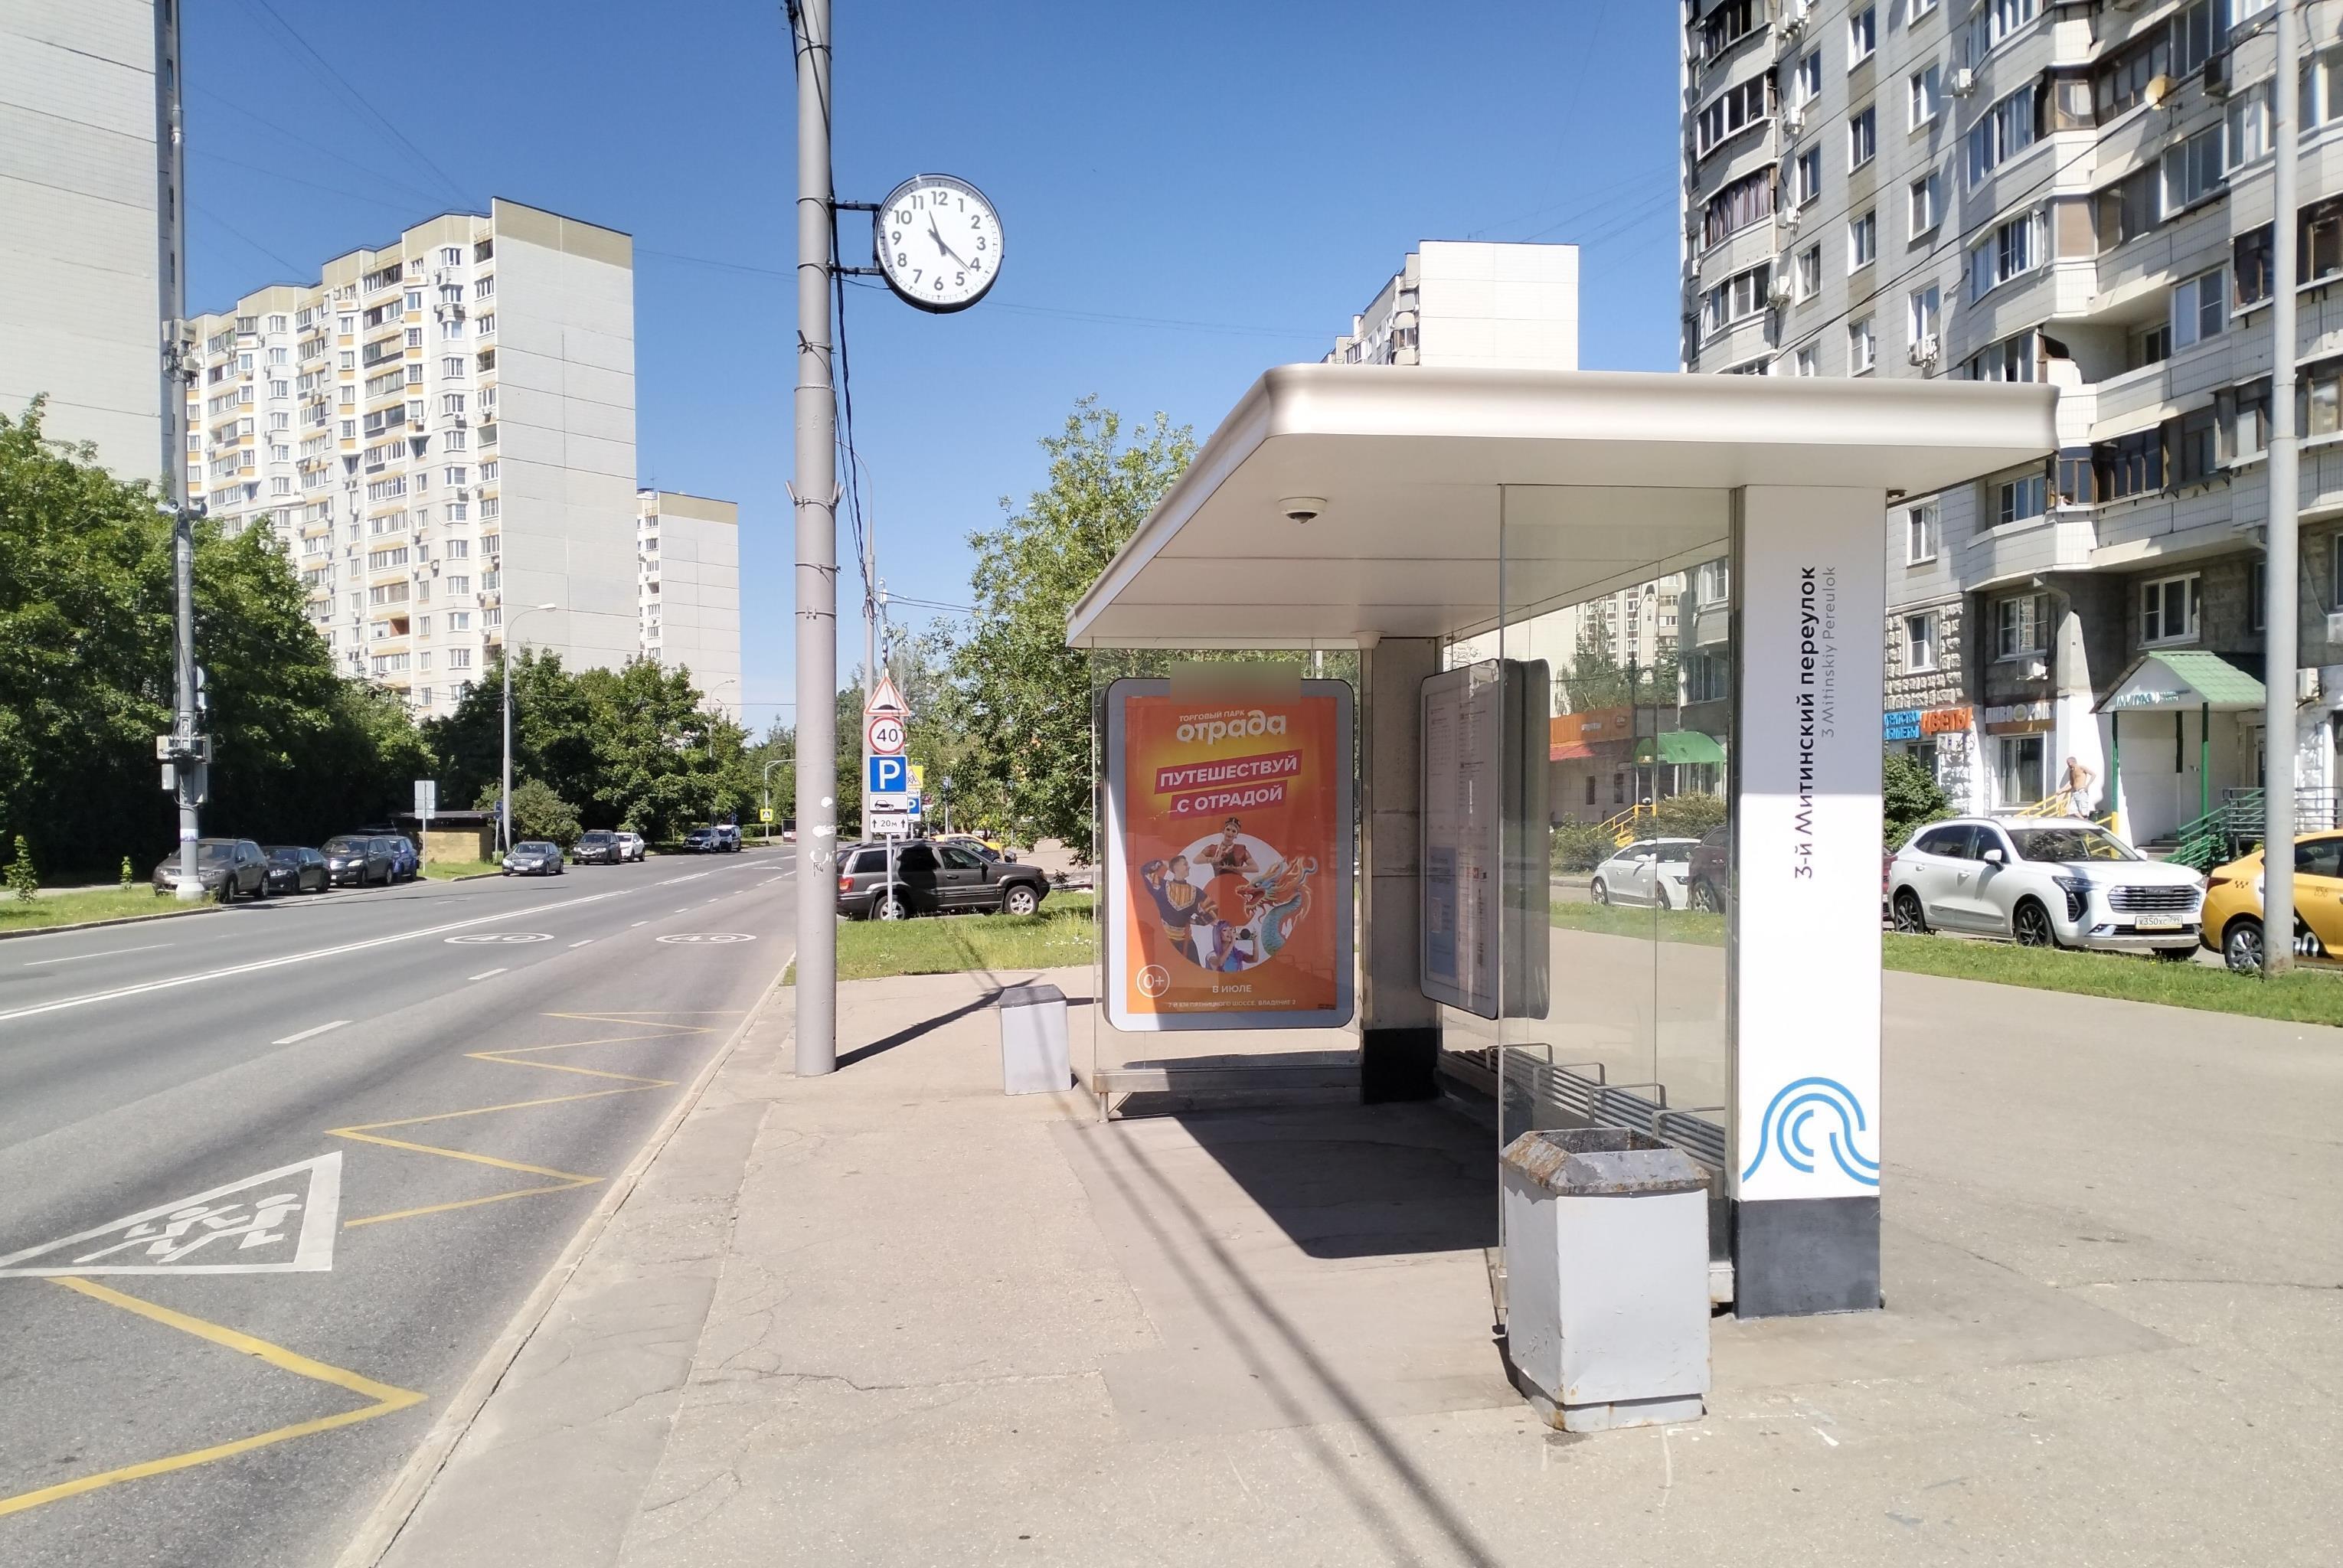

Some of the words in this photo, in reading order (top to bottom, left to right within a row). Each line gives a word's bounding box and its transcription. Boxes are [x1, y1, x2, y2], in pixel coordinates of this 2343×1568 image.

[910, 195, 923, 210] 11
[931, 191, 948, 205] 12
[958, 198, 963, 213] 1
[894, 210, 913, 224] 10
[971, 214, 981, 230] 2
[891, 231, 902, 245] 9
[976, 237, 986, 250] 3
[897, 253, 907, 267] 8
[969, 257, 982, 272] 4
[913, 270, 923, 283] 7
[934, 276, 943, 291] 6
[956, 272, 965, 286] 5
[1822, 567, 1835, 639] Pereulok
[1801, 567, 1819, 684] переулок
[1822, 645, 1838, 724] Mitinskiy
[1179, 710, 1222, 722] ТОРГОВЫЙ
[1224, 710, 1244, 718] ПАРК
[1921, 707, 1973, 737] ЦВЕТЫ
[877, 729, 898, 743] 40
[1822, 728, 1835, 738] 3
[1160, 755, 1297, 787] ПУТЕШЕСТВУЙ
[1795, 694, 1814, 835] Митинский
[880, 760, 900, 789] P
[1177, 799, 1189, 813] С
[1194, 785, 1283, 810] ОТРАДОЙ
[1795, 844, 1812, 878] 3-й
[1143, 974, 1165, 989] 0+
[1213, 985, 1219, 994] В
[1221, 985, 1252, 993] ИЮЛЕ
